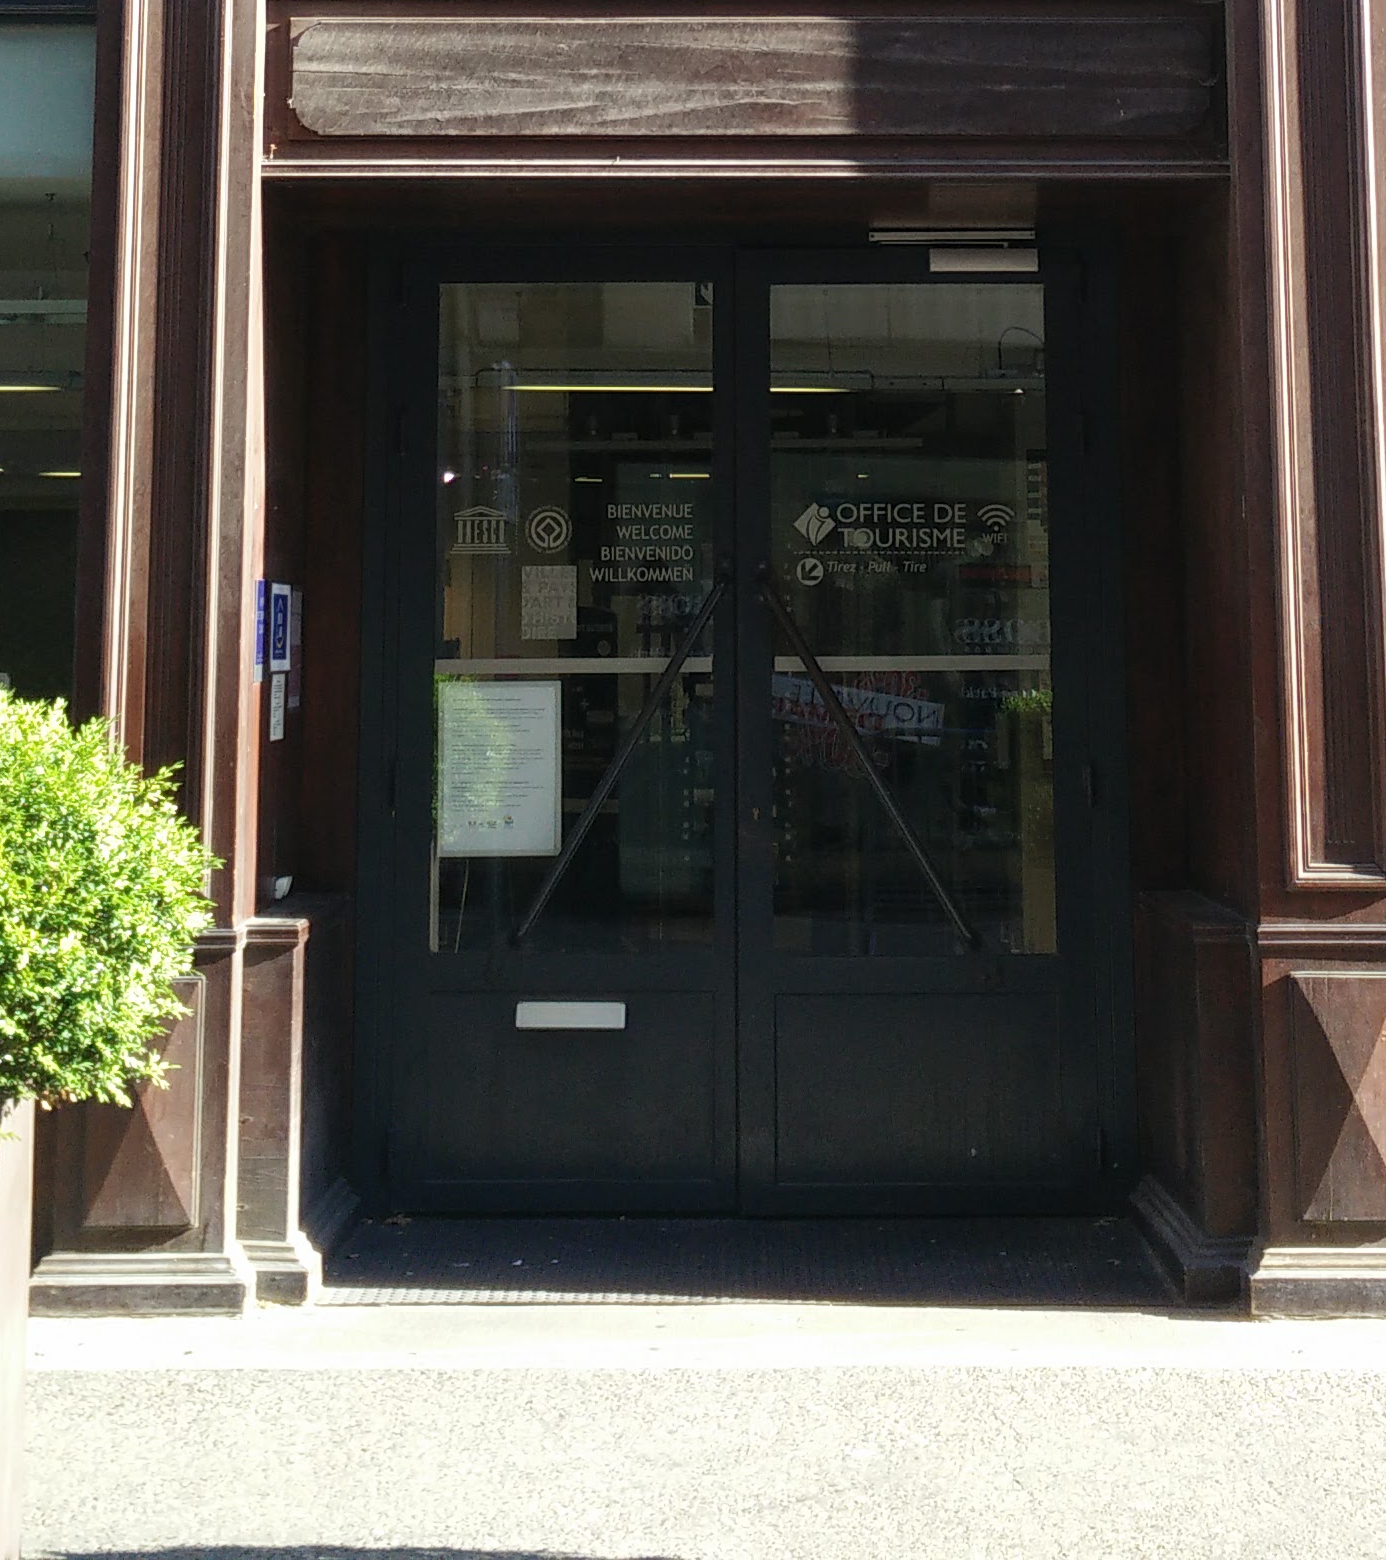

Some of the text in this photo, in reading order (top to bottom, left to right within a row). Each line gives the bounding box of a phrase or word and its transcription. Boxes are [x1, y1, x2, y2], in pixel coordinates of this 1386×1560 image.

[607, 504, 694, 519] BIENVENUE
[836, 503, 967, 524] OFFICE DE
[616, 525, 694, 540] WELCOME
[838, 528, 967, 549] TOURISME
[600, 545, 694, 561] BIENVENIDO
[589, 566, 694, 582] WILLKOMMEN
[827, 561, 856, 573] Tirez
[868, 561, 891, 573] Pull
[903, 561, 927, 573] Tire
